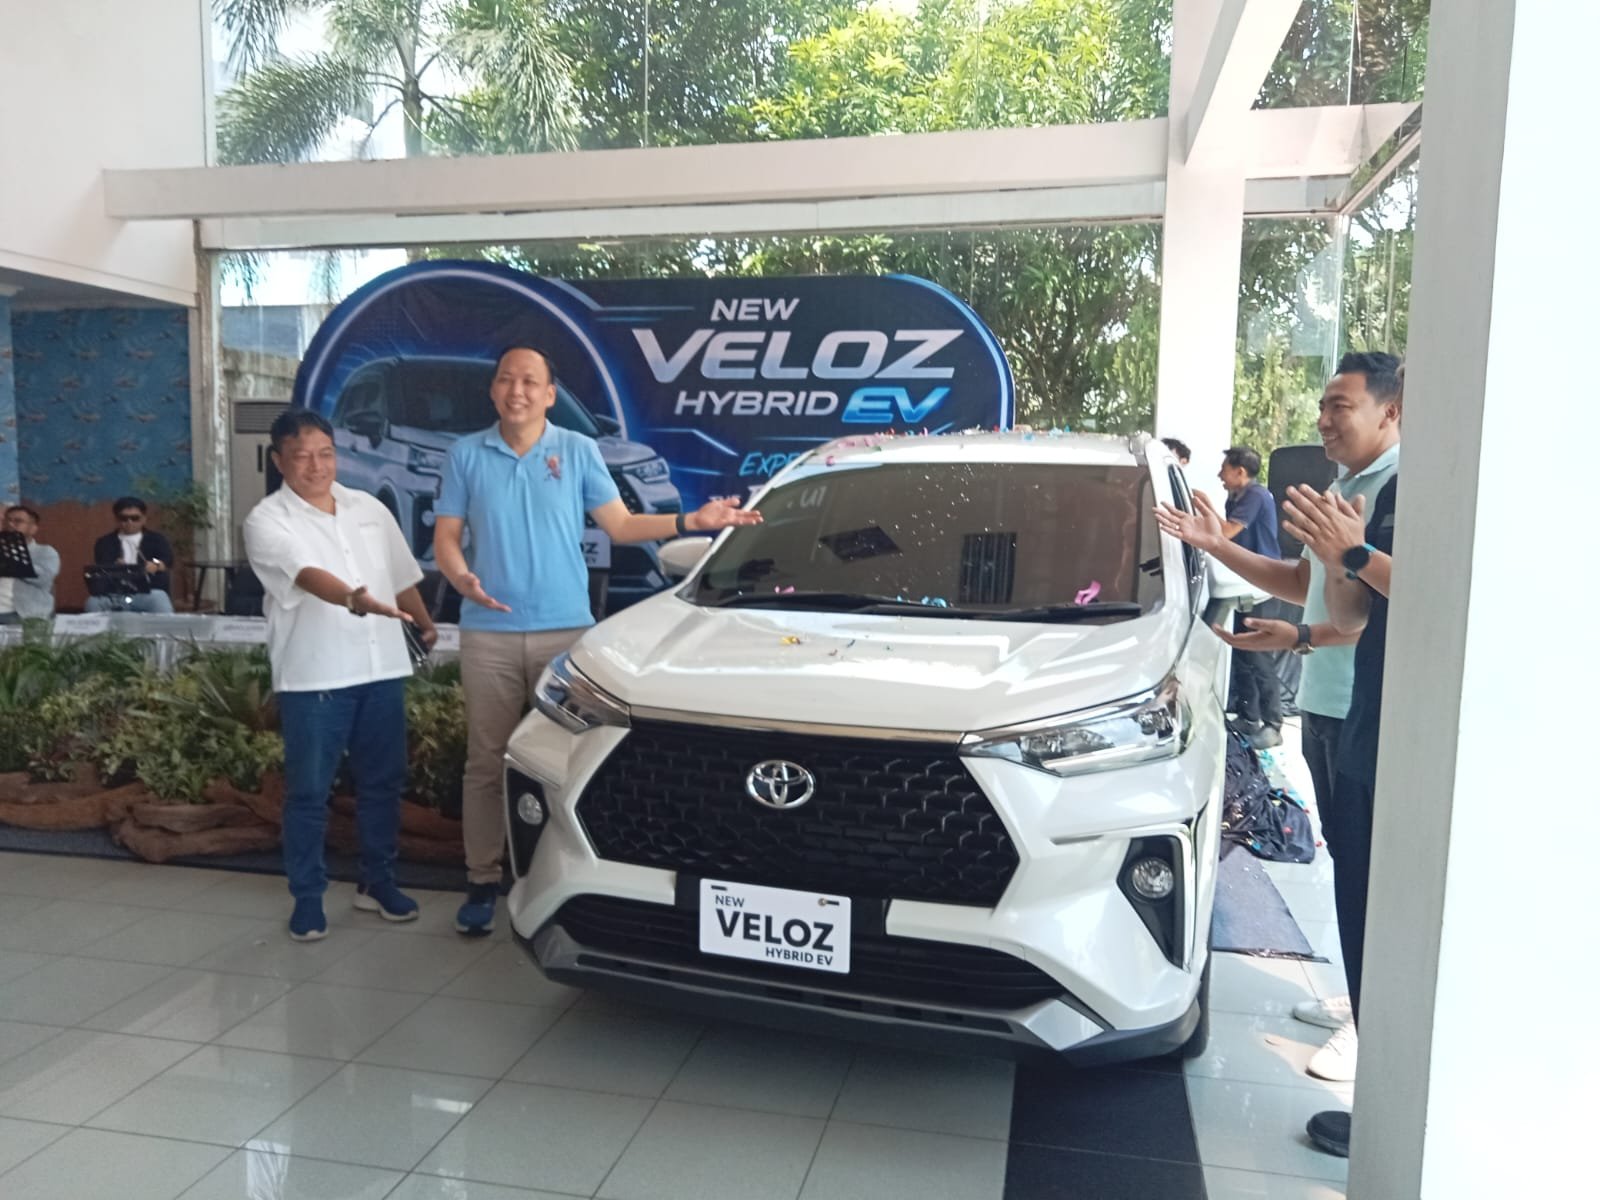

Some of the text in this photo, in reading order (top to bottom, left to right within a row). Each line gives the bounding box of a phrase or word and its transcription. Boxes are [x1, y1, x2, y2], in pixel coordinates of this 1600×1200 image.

[710, 298, 799, 321] NEW
[632, 328, 964, 383] VELOZ
[674, 386, 951, 423] HYBRID EV
[715, 894, 745, 908] NEW
[716, 908, 834, 952] VELOZ
[765, 947, 833, 966] HYBRID EV
